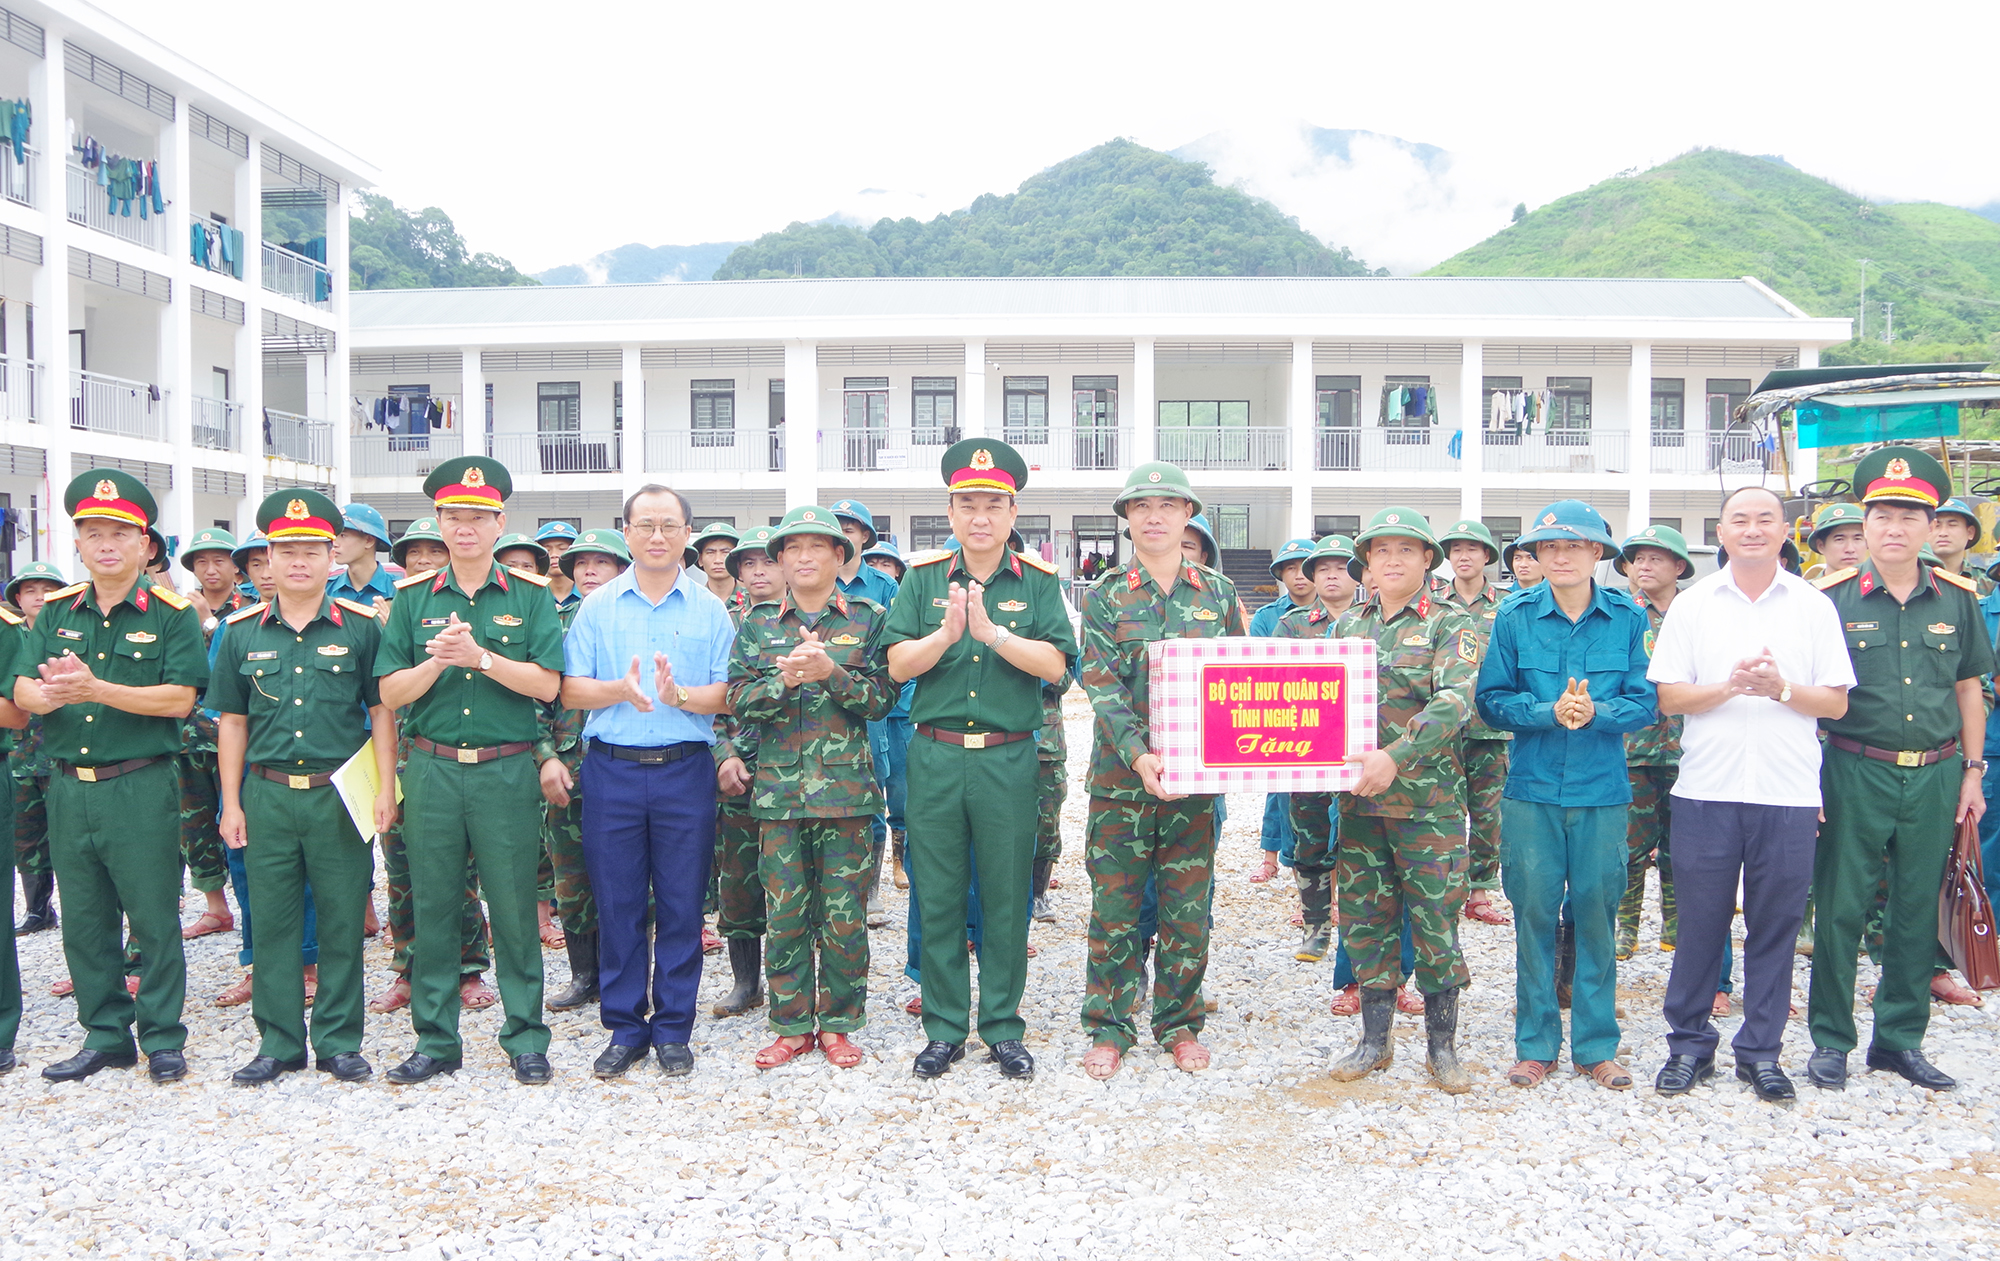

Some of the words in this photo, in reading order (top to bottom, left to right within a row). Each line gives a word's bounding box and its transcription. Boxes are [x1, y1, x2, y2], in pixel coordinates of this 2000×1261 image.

[1209, 678, 1227, 705] BỘ
[1229, 676, 1252, 702] CHỈ
[1254, 682, 1280, 701] HUY
[1283, 678, 1318, 703] QUÂN
[1321, 679, 1340, 704] SỰ
[1231, 703, 1260, 728] TỈNH
[1264, 705, 1297, 731] NGHỆ
[1301, 708, 1319, 727] AN
[1236, 733, 1313, 757] Tặng
